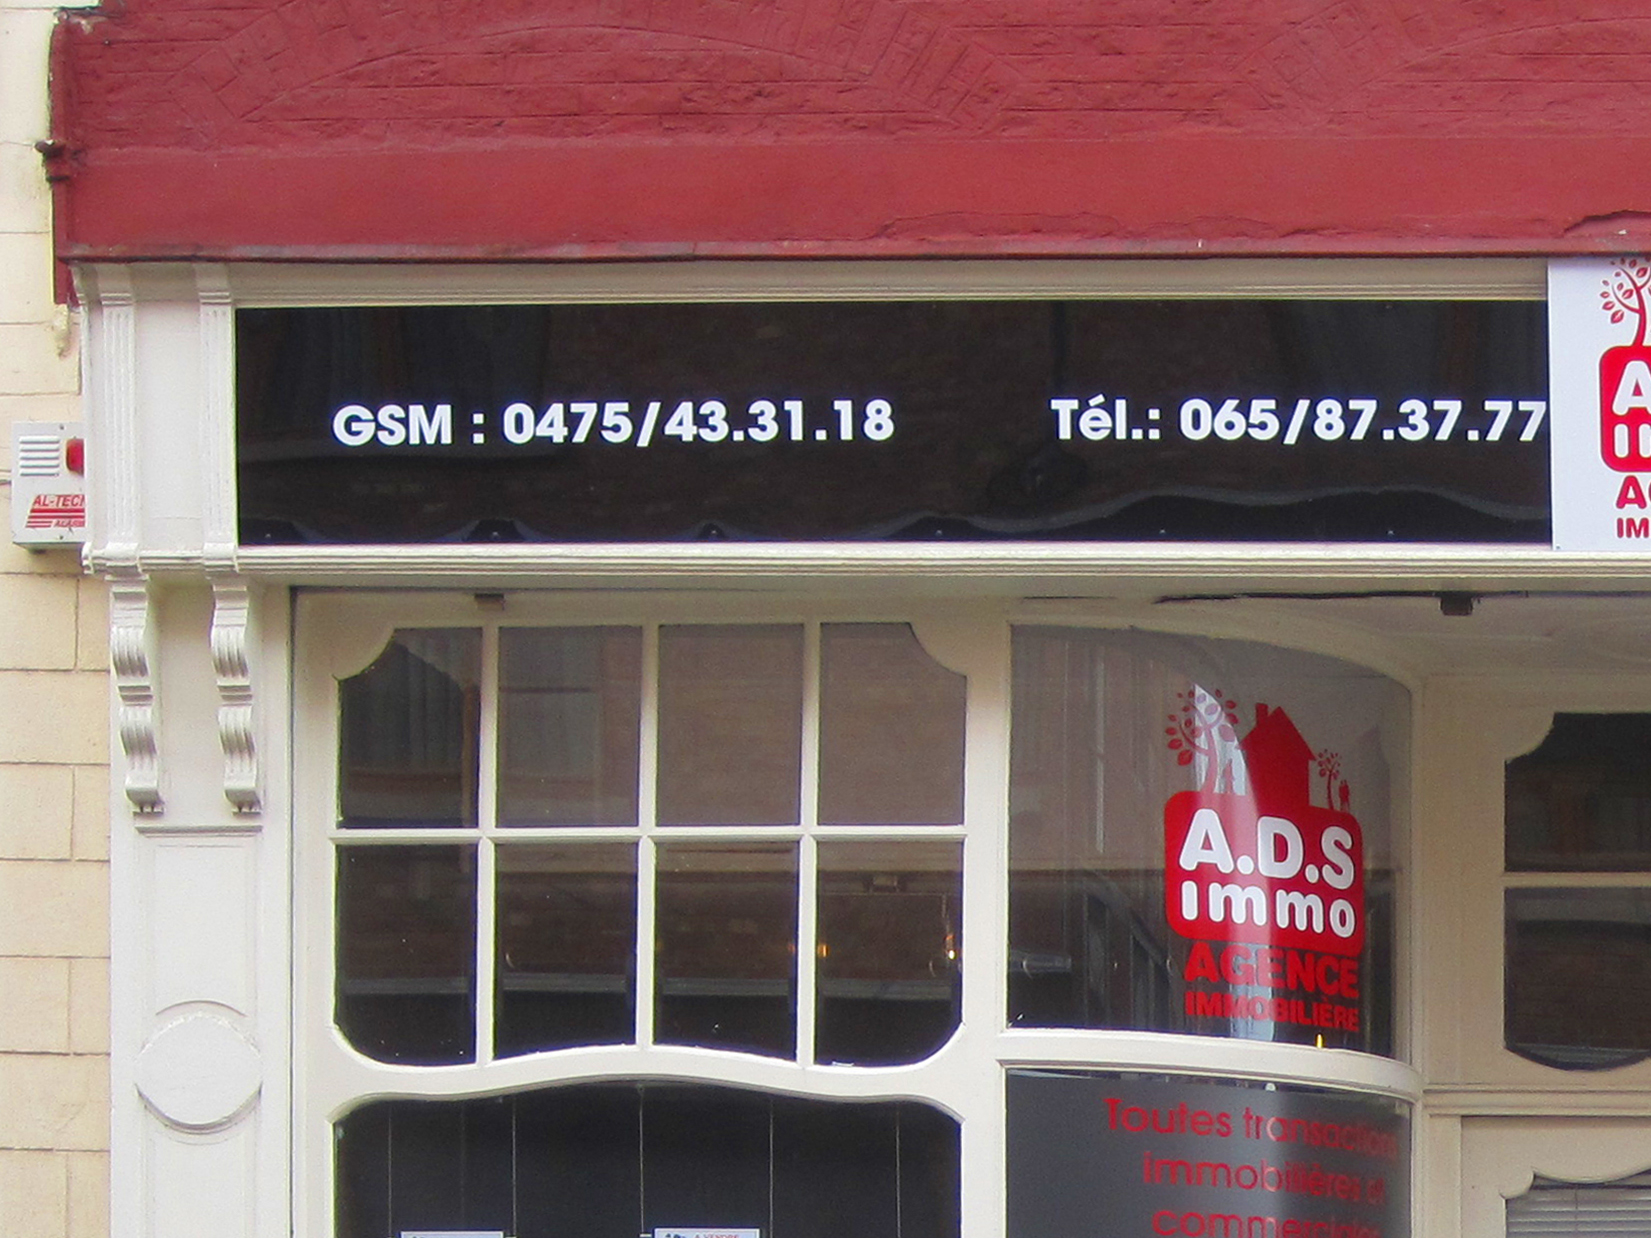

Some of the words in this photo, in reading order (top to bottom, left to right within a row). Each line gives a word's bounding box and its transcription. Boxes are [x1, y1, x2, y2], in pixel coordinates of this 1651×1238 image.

[333, 405, 452, 445] GSM
[502, 399, 895, 446] 0475/43.31.18
[1180, 399, 1547, 445] 065/87.37.77
[1180, 808, 1354, 889] A.D.S
[1182, 881, 1356, 938] immo
[1184, 941, 1359, 998] AGENCE
[1185, 990, 1359, 1032] IMMOBILIÈRE
[1103, 1098, 1232, 1137] Toutes
